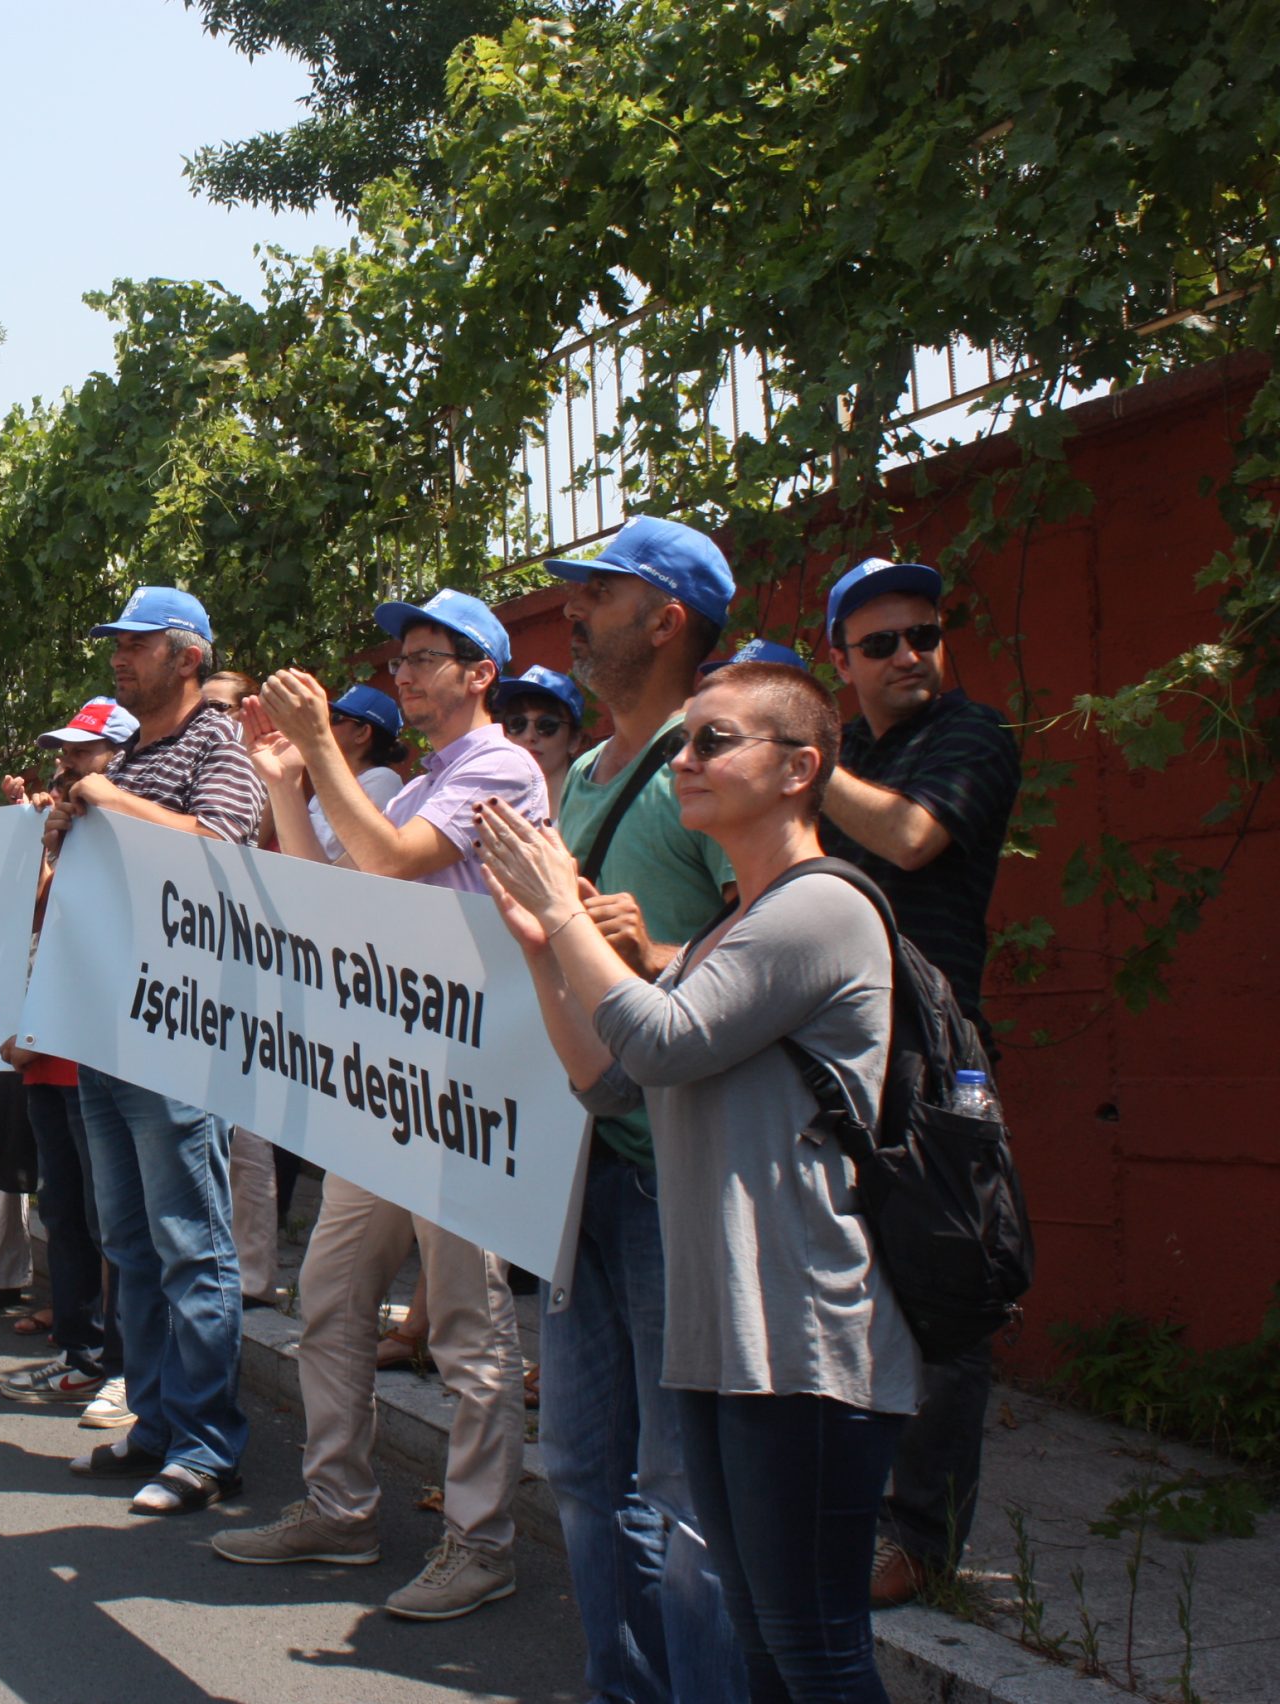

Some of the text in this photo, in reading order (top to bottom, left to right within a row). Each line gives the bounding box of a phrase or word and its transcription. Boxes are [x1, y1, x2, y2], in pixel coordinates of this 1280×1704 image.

[129, 961, 518, 1178] işçiler yalnız değildir!
[331, 942, 485, 1049] çalışanı
